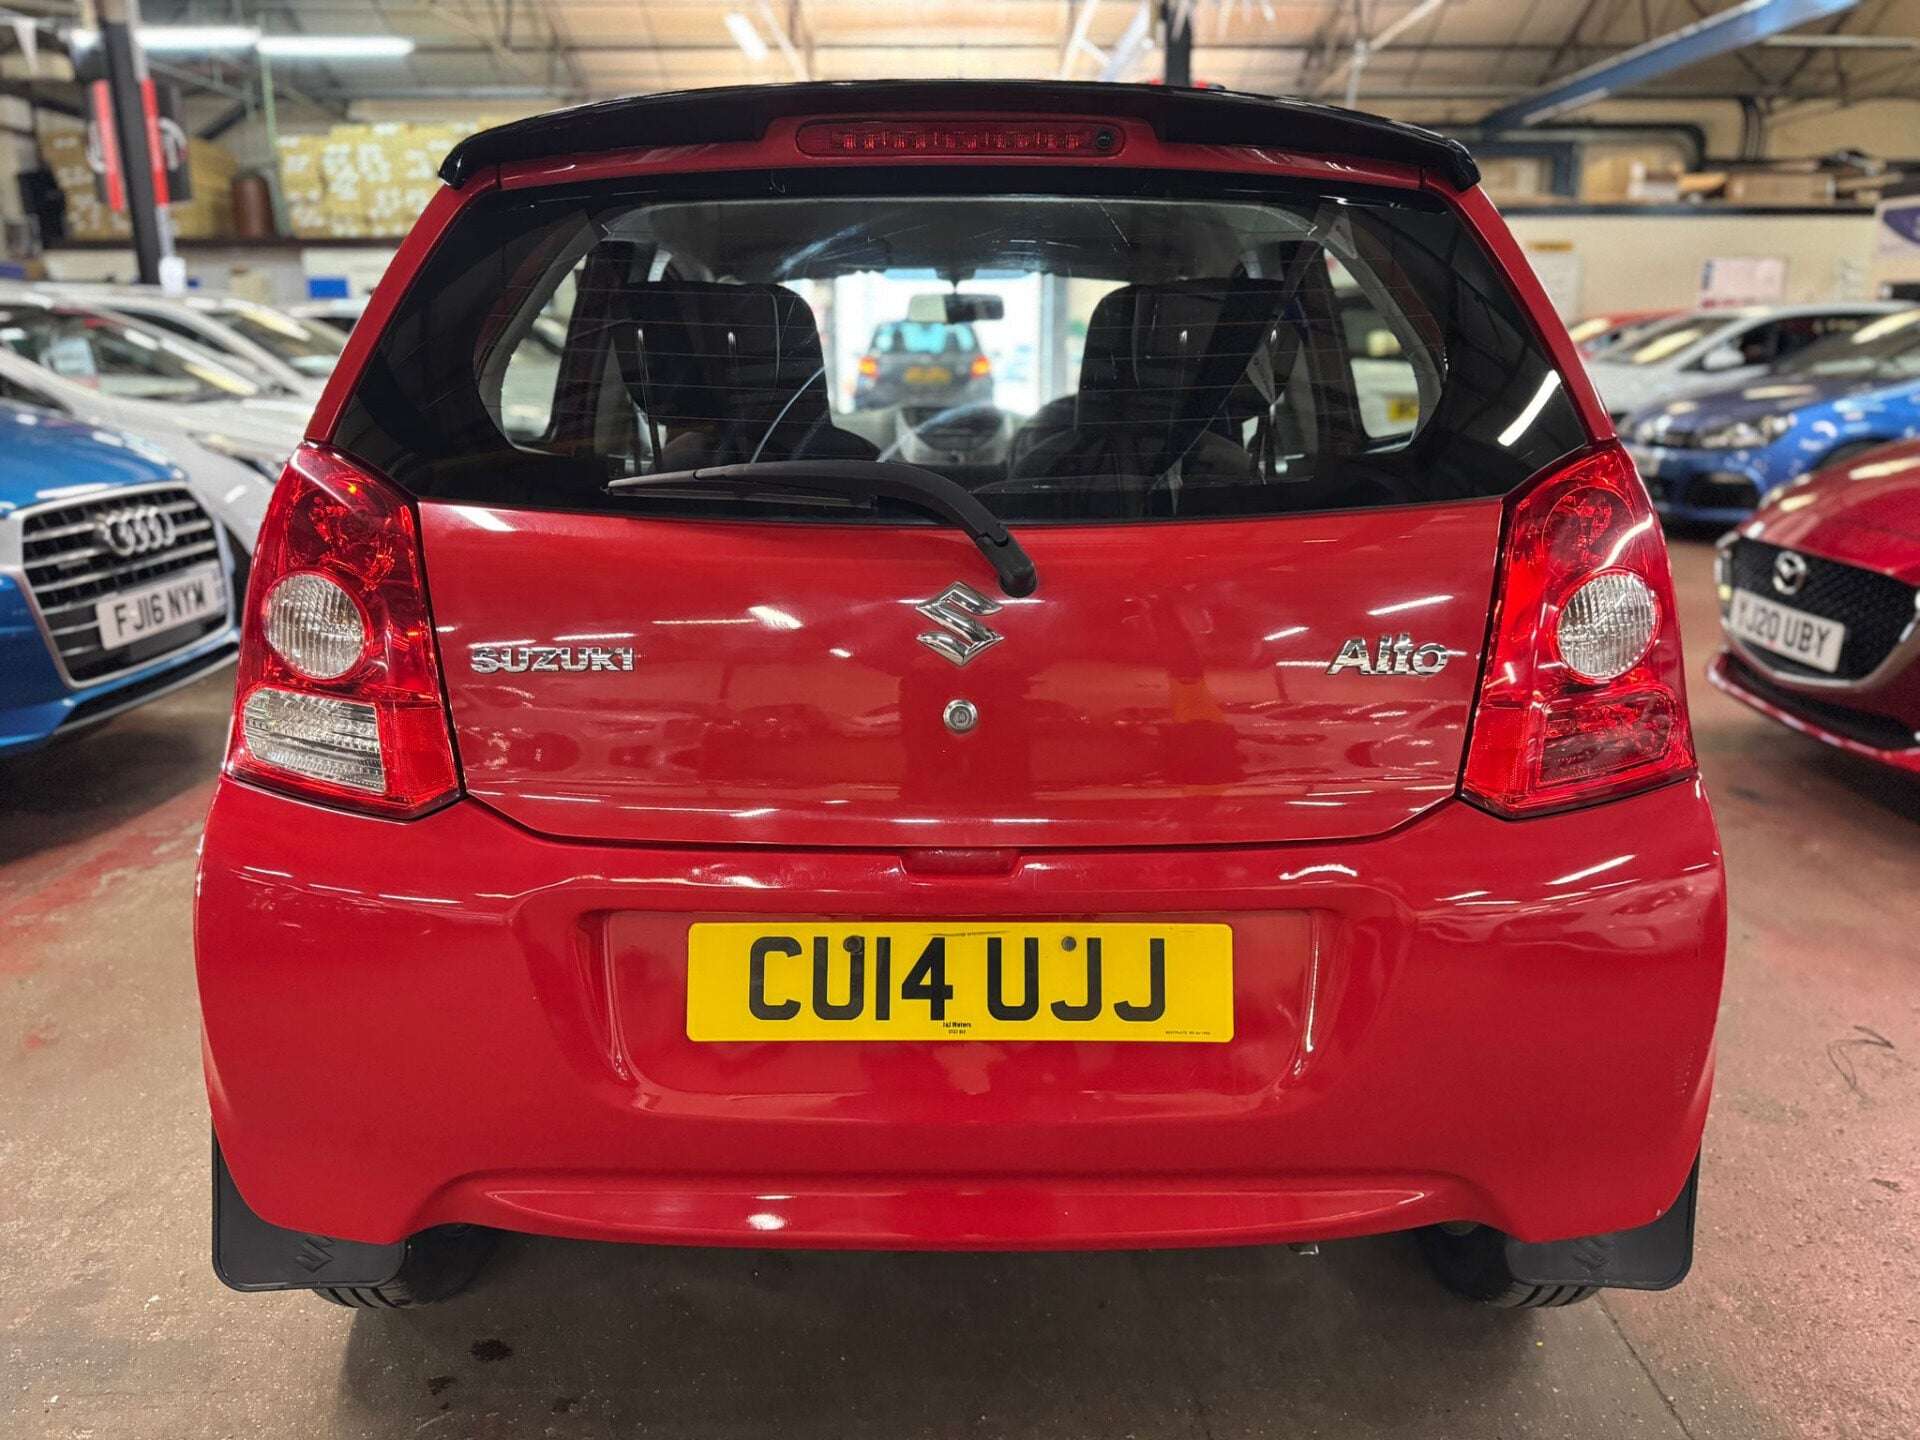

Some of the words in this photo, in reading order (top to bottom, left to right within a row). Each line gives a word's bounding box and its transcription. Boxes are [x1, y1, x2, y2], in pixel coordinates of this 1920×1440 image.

[113, 593, 165, 637] FJ16
[1784, 616, 1831, 658] UBY
[470, 645, 634, 673] SUZUKI
[1326, 632, 1449, 676] Alto
[749, 936, 954, 1020] CU14
[987, 937, 1166, 1021] UJJ
